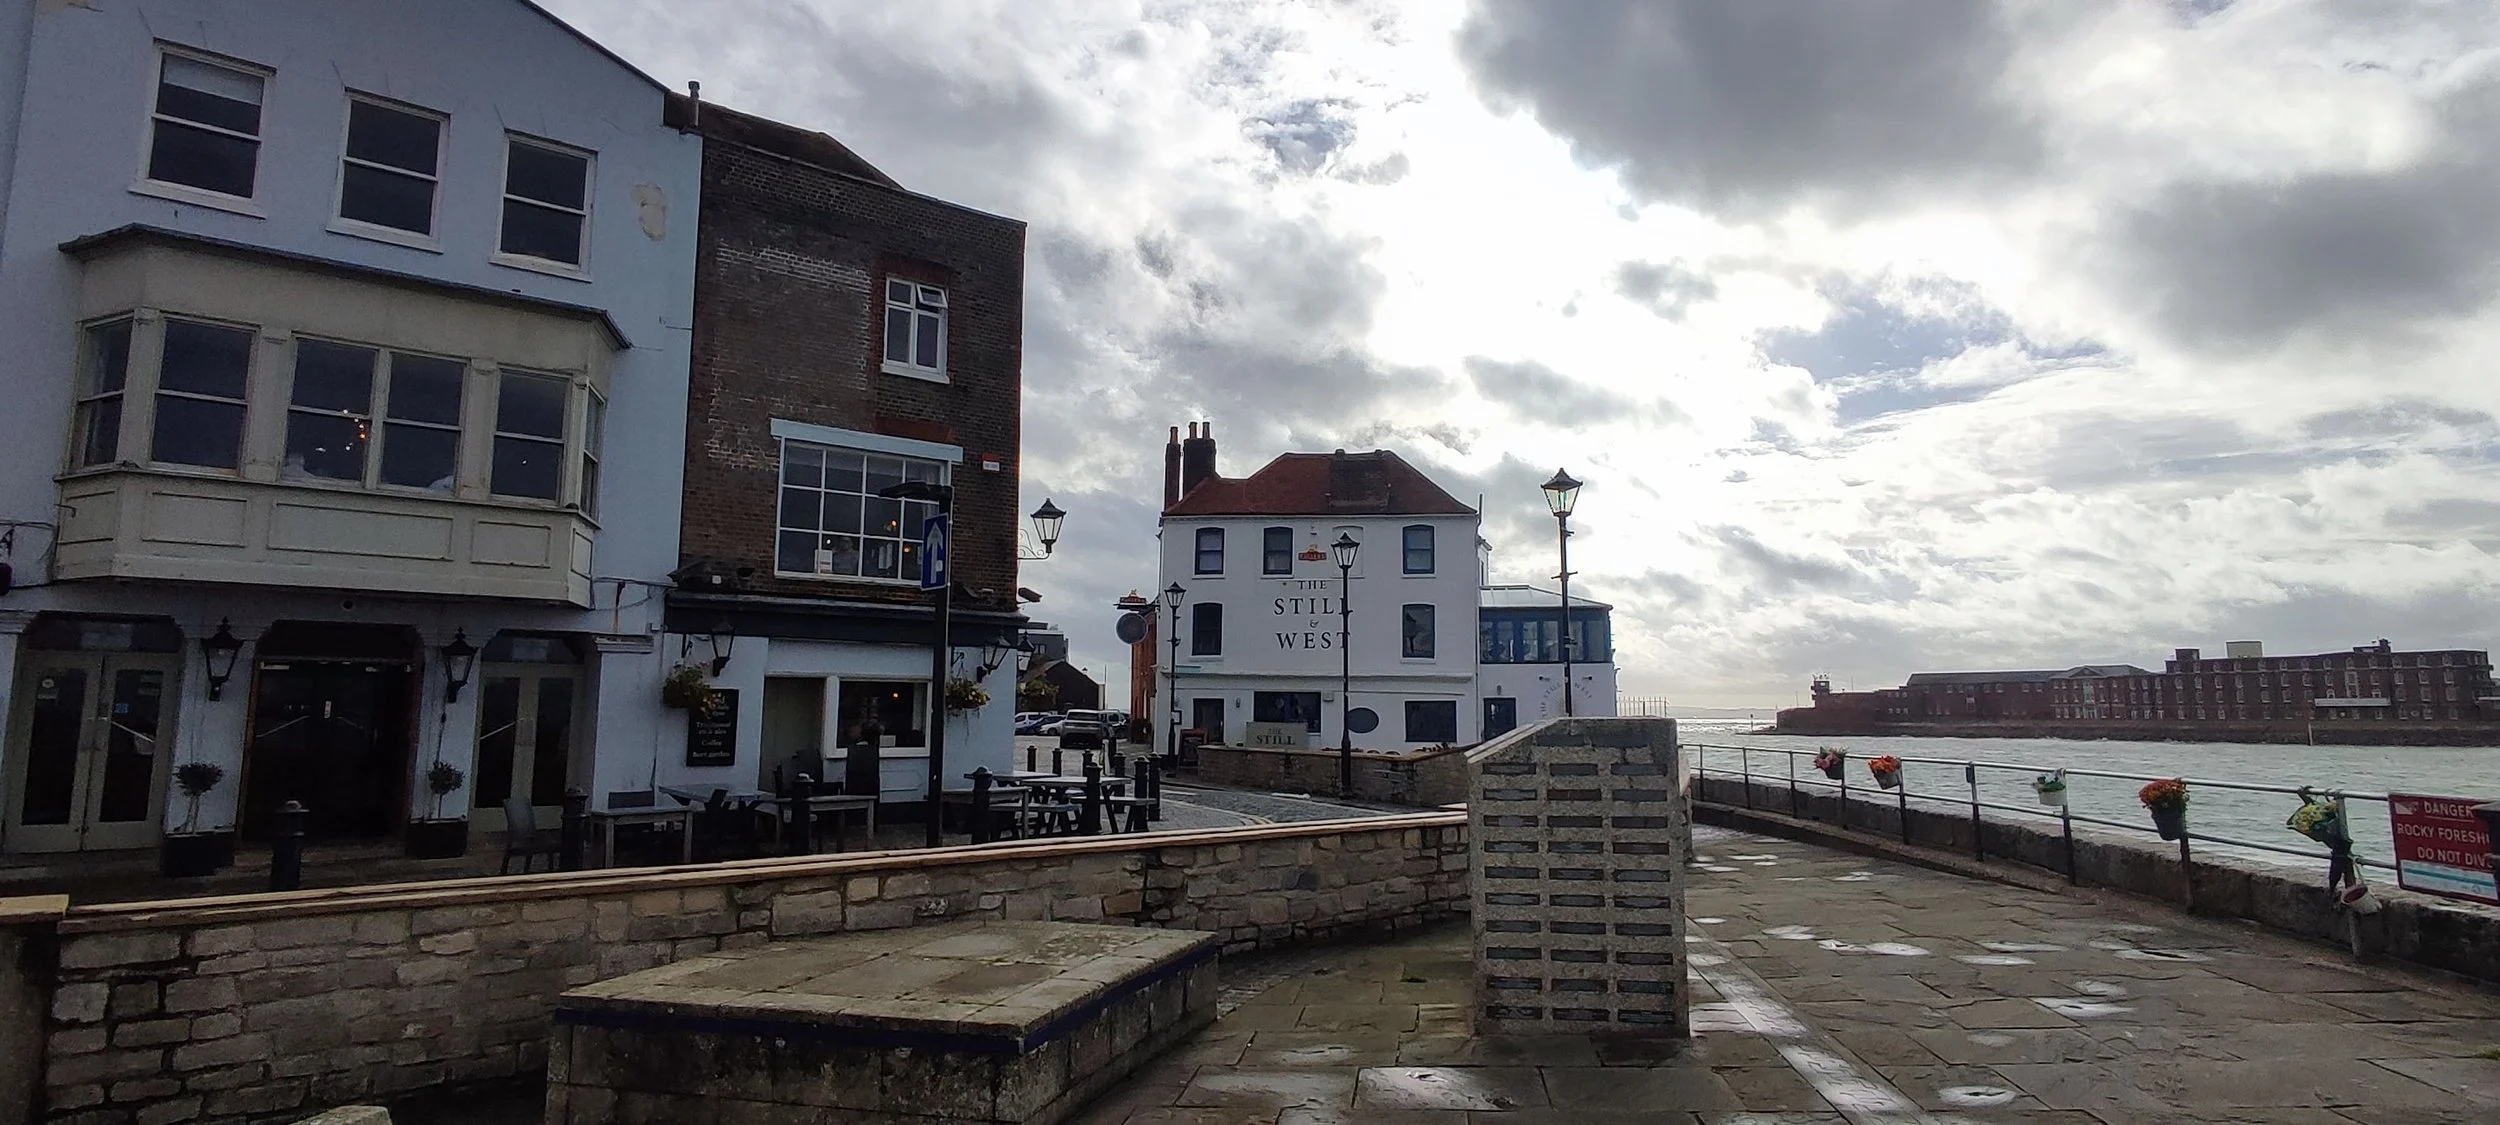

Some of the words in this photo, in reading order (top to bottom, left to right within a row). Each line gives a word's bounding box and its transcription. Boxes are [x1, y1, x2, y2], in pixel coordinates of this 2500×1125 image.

[1298, 580, 1327, 590] THE
[1310, 620, 1319, 628] &
[1276, 632, 1350, 649] WEST
[1257, 735, 1297, 745] STILL
[2424, 801, 2475, 818] DANGER
[2396, 823, 2434, 838] ROCKY
[2417, 847, 2434, 860] DO
[2437, 850, 2460, 864] NOT
